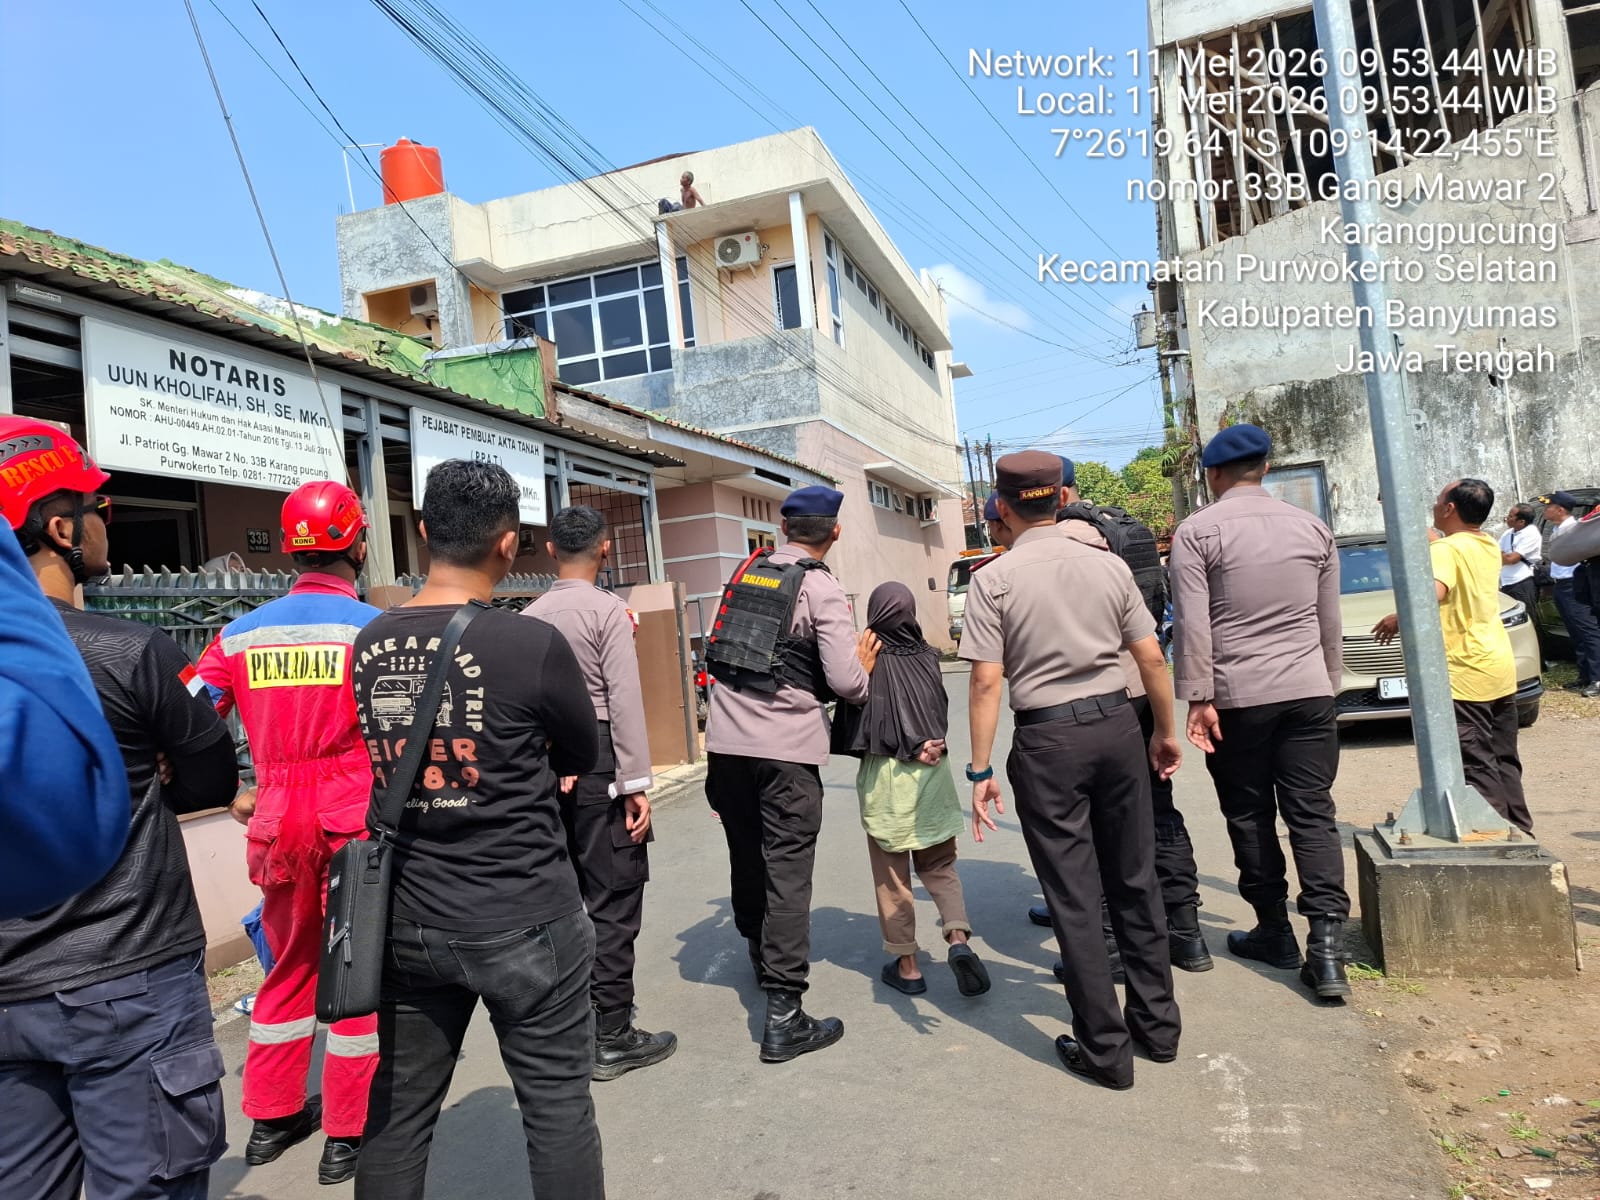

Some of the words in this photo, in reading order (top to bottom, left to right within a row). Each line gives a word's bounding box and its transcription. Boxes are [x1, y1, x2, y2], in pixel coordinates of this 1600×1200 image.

[169, 348, 286, 397] NOTARIS
[107, 363, 148, 389] UUN
[154, 373, 242, 413] KHOLIFAH,
[246, 395, 271, 419] SH,
[274, 402, 297, 424] SE,
[299, 408, 332, 429] MKn.
[110, 405, 148, 421] NOMOR
[262, 435, 280, 447] 2016
[294, 441, 303, 451] 13
[157, 401, 189, 417] Menteri
[190, 407, 220, 422] Hukum
[221, 415, 236, 426] dan
[237, 417, 252, 428] Hak
[253, 421, 273, 434] Asasi
[274, 425, 303, 440] Manusia
[303, 431, 312, 441] RI
[422, 415, 459, 437] PEJABAT
[461, 426, 496, 446] PEMBUAT
[498, 436, 516, 451] AKTA
[517, 440, 540, 457] TANAH
[0, 444, 78, 489] RESCUE
[135, 435, 170, 452] Patriot
[171, 442, 190, 457] Gg.
[192, 445, 223, 460] Mawar
[225, 451, 231, 462] 2
[233, 452, 249, 465] No.
[250, 455, 267, 468] 33B
[269, 459, 298, 475] Karang
[299, 465, 330, 480] pucung
[160, 455, 217, 474] Purwokerto
[219, 465, 240, 479] Telp.
[267, 472, 301, 487] 7772246
[249, 531, 269, 545] 33B
[294, 537, 314, 545] KONG
[741, 573, 781, 589] BRIMOB
[251, 650, 339, 682] PEMADAM
[390, 655, 425, 664] STAY
[390, 664, 425, 672] SAFE
[354, 637, 397, 673] TAKE
[404, 636, 418, 650] A
[425, 637, 482, 679] RAD
[465, 687, 484, 733] TRIP
[1382, 680, 1390, 692] R
[431, 796, 469, 808] Goods
